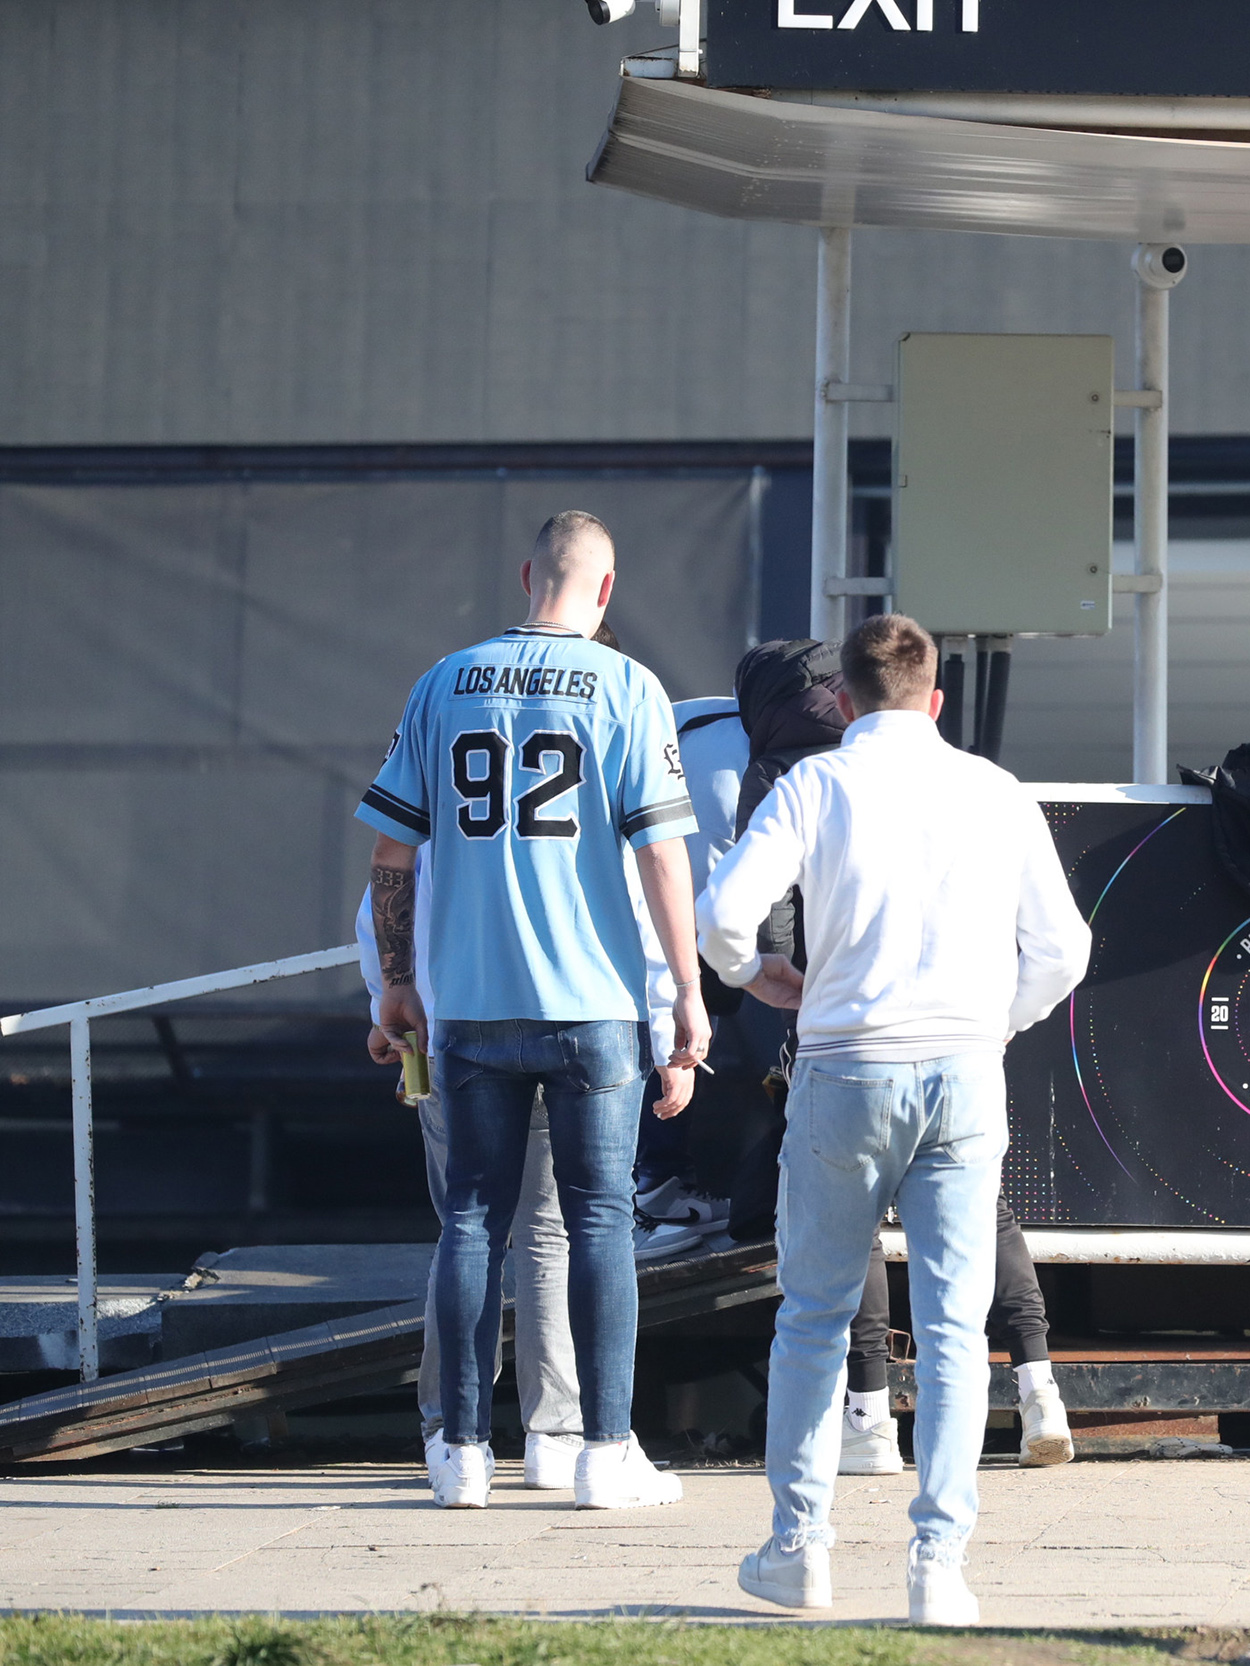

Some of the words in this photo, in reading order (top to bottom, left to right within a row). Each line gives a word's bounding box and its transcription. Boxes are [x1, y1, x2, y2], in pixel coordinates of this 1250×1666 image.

[453, 666, 496, 696] LOS
[493, 666, 598, 699] ANGELES
[449, 728, 588, 841] 92
[374, 868, 404, 888] 333
[1210, 1005, 1229, 1022] 20
